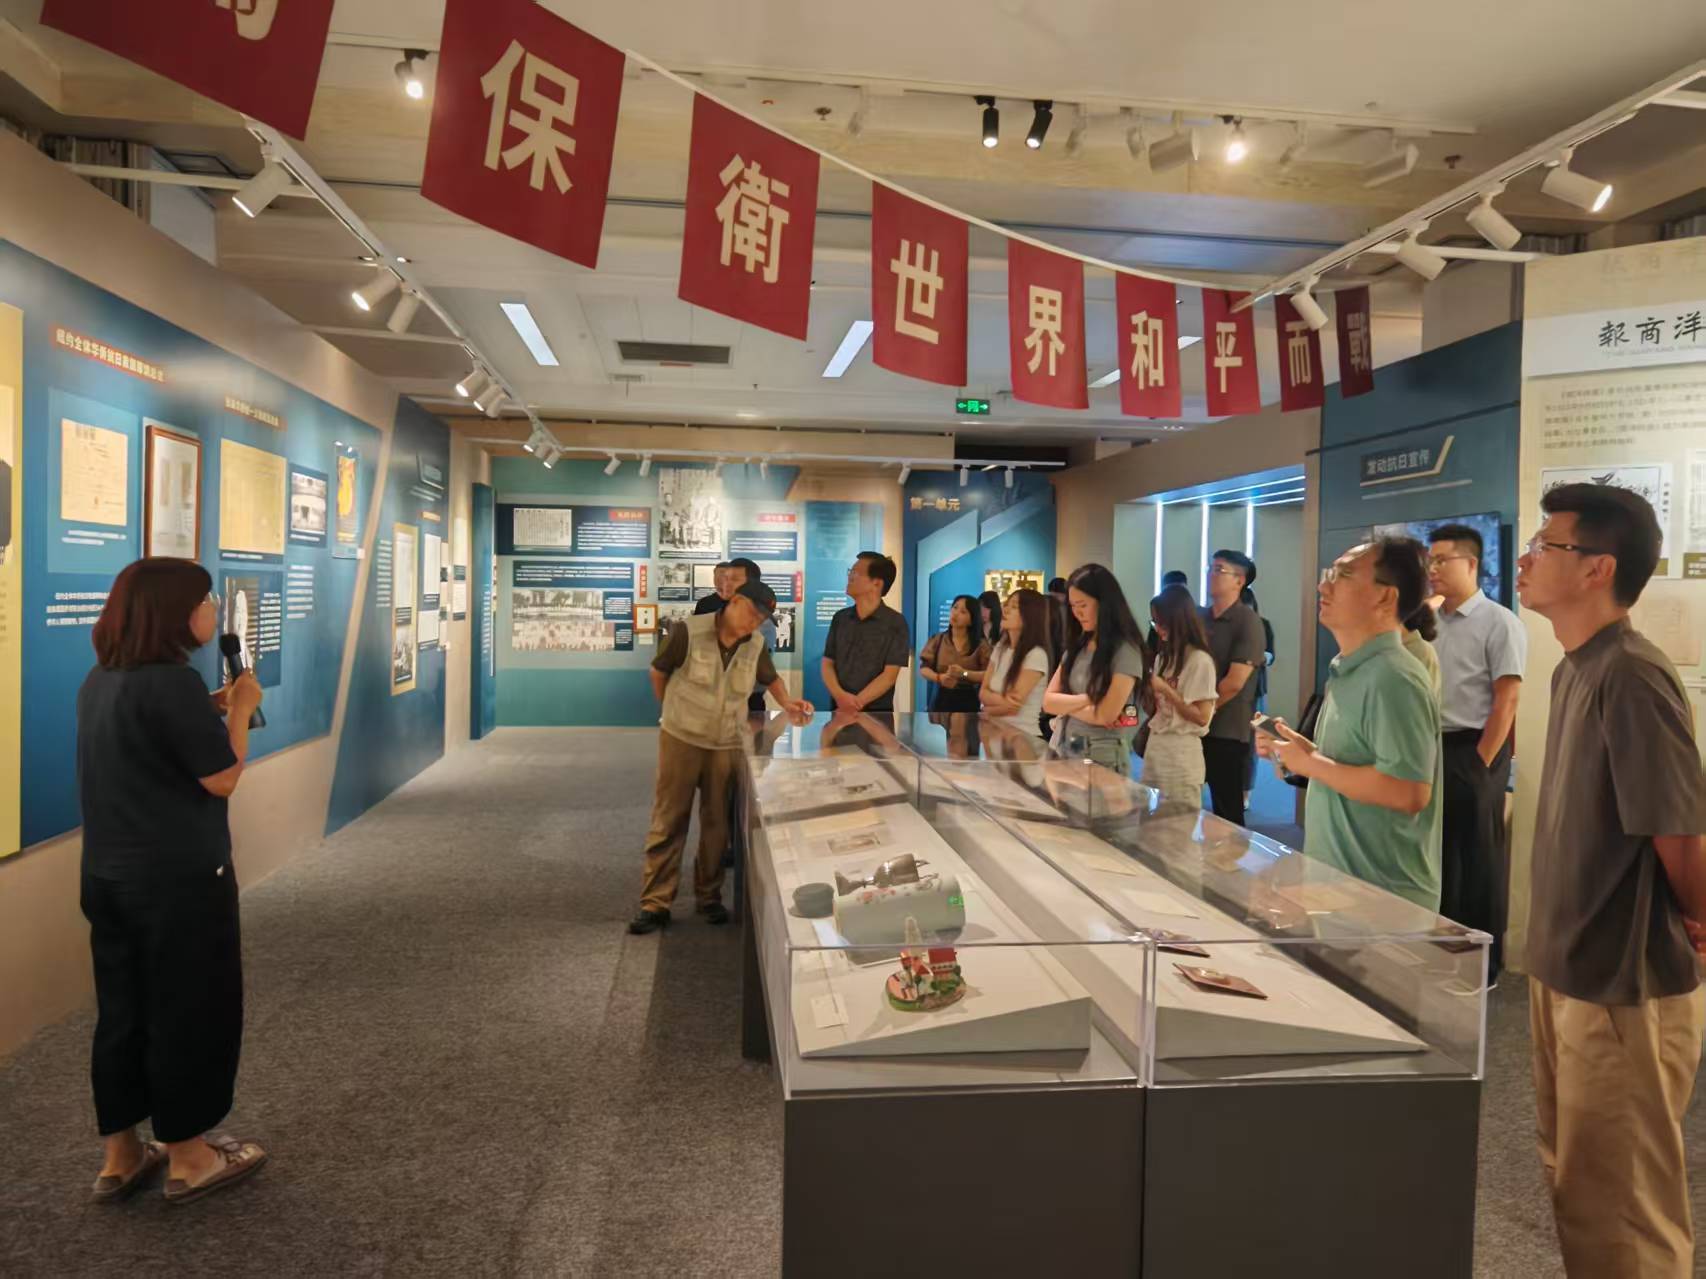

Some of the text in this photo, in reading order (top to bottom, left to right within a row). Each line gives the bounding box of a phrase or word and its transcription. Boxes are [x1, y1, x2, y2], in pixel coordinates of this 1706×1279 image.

[480, 39, 581, 195] 保
[715, 154, 791, 284] 衛
[890, 239, 944, 345] 世
[1023, 284, 1066, 377] 界
[1130, 310, 1165, 390] 和
[1213, 321, 1243, 394] 平
[1285, 319, 1313, 388] 而
